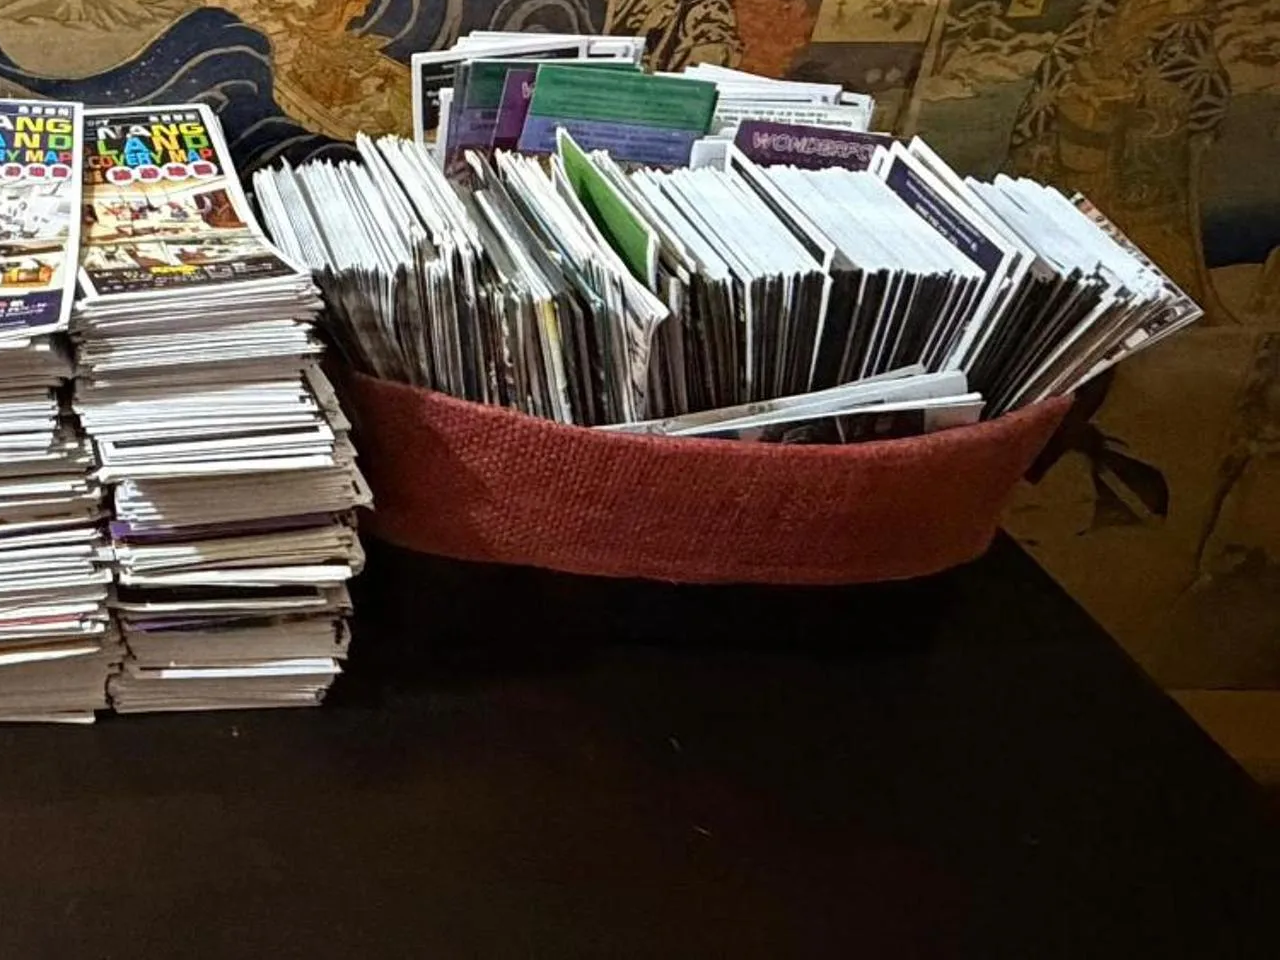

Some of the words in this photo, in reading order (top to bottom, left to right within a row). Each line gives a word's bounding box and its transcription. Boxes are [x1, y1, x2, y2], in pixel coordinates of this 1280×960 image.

[97, 123, 205, 138] NANG
[96, 135, 209, 155] LAND
[24, 149, 73, 164] MAP
